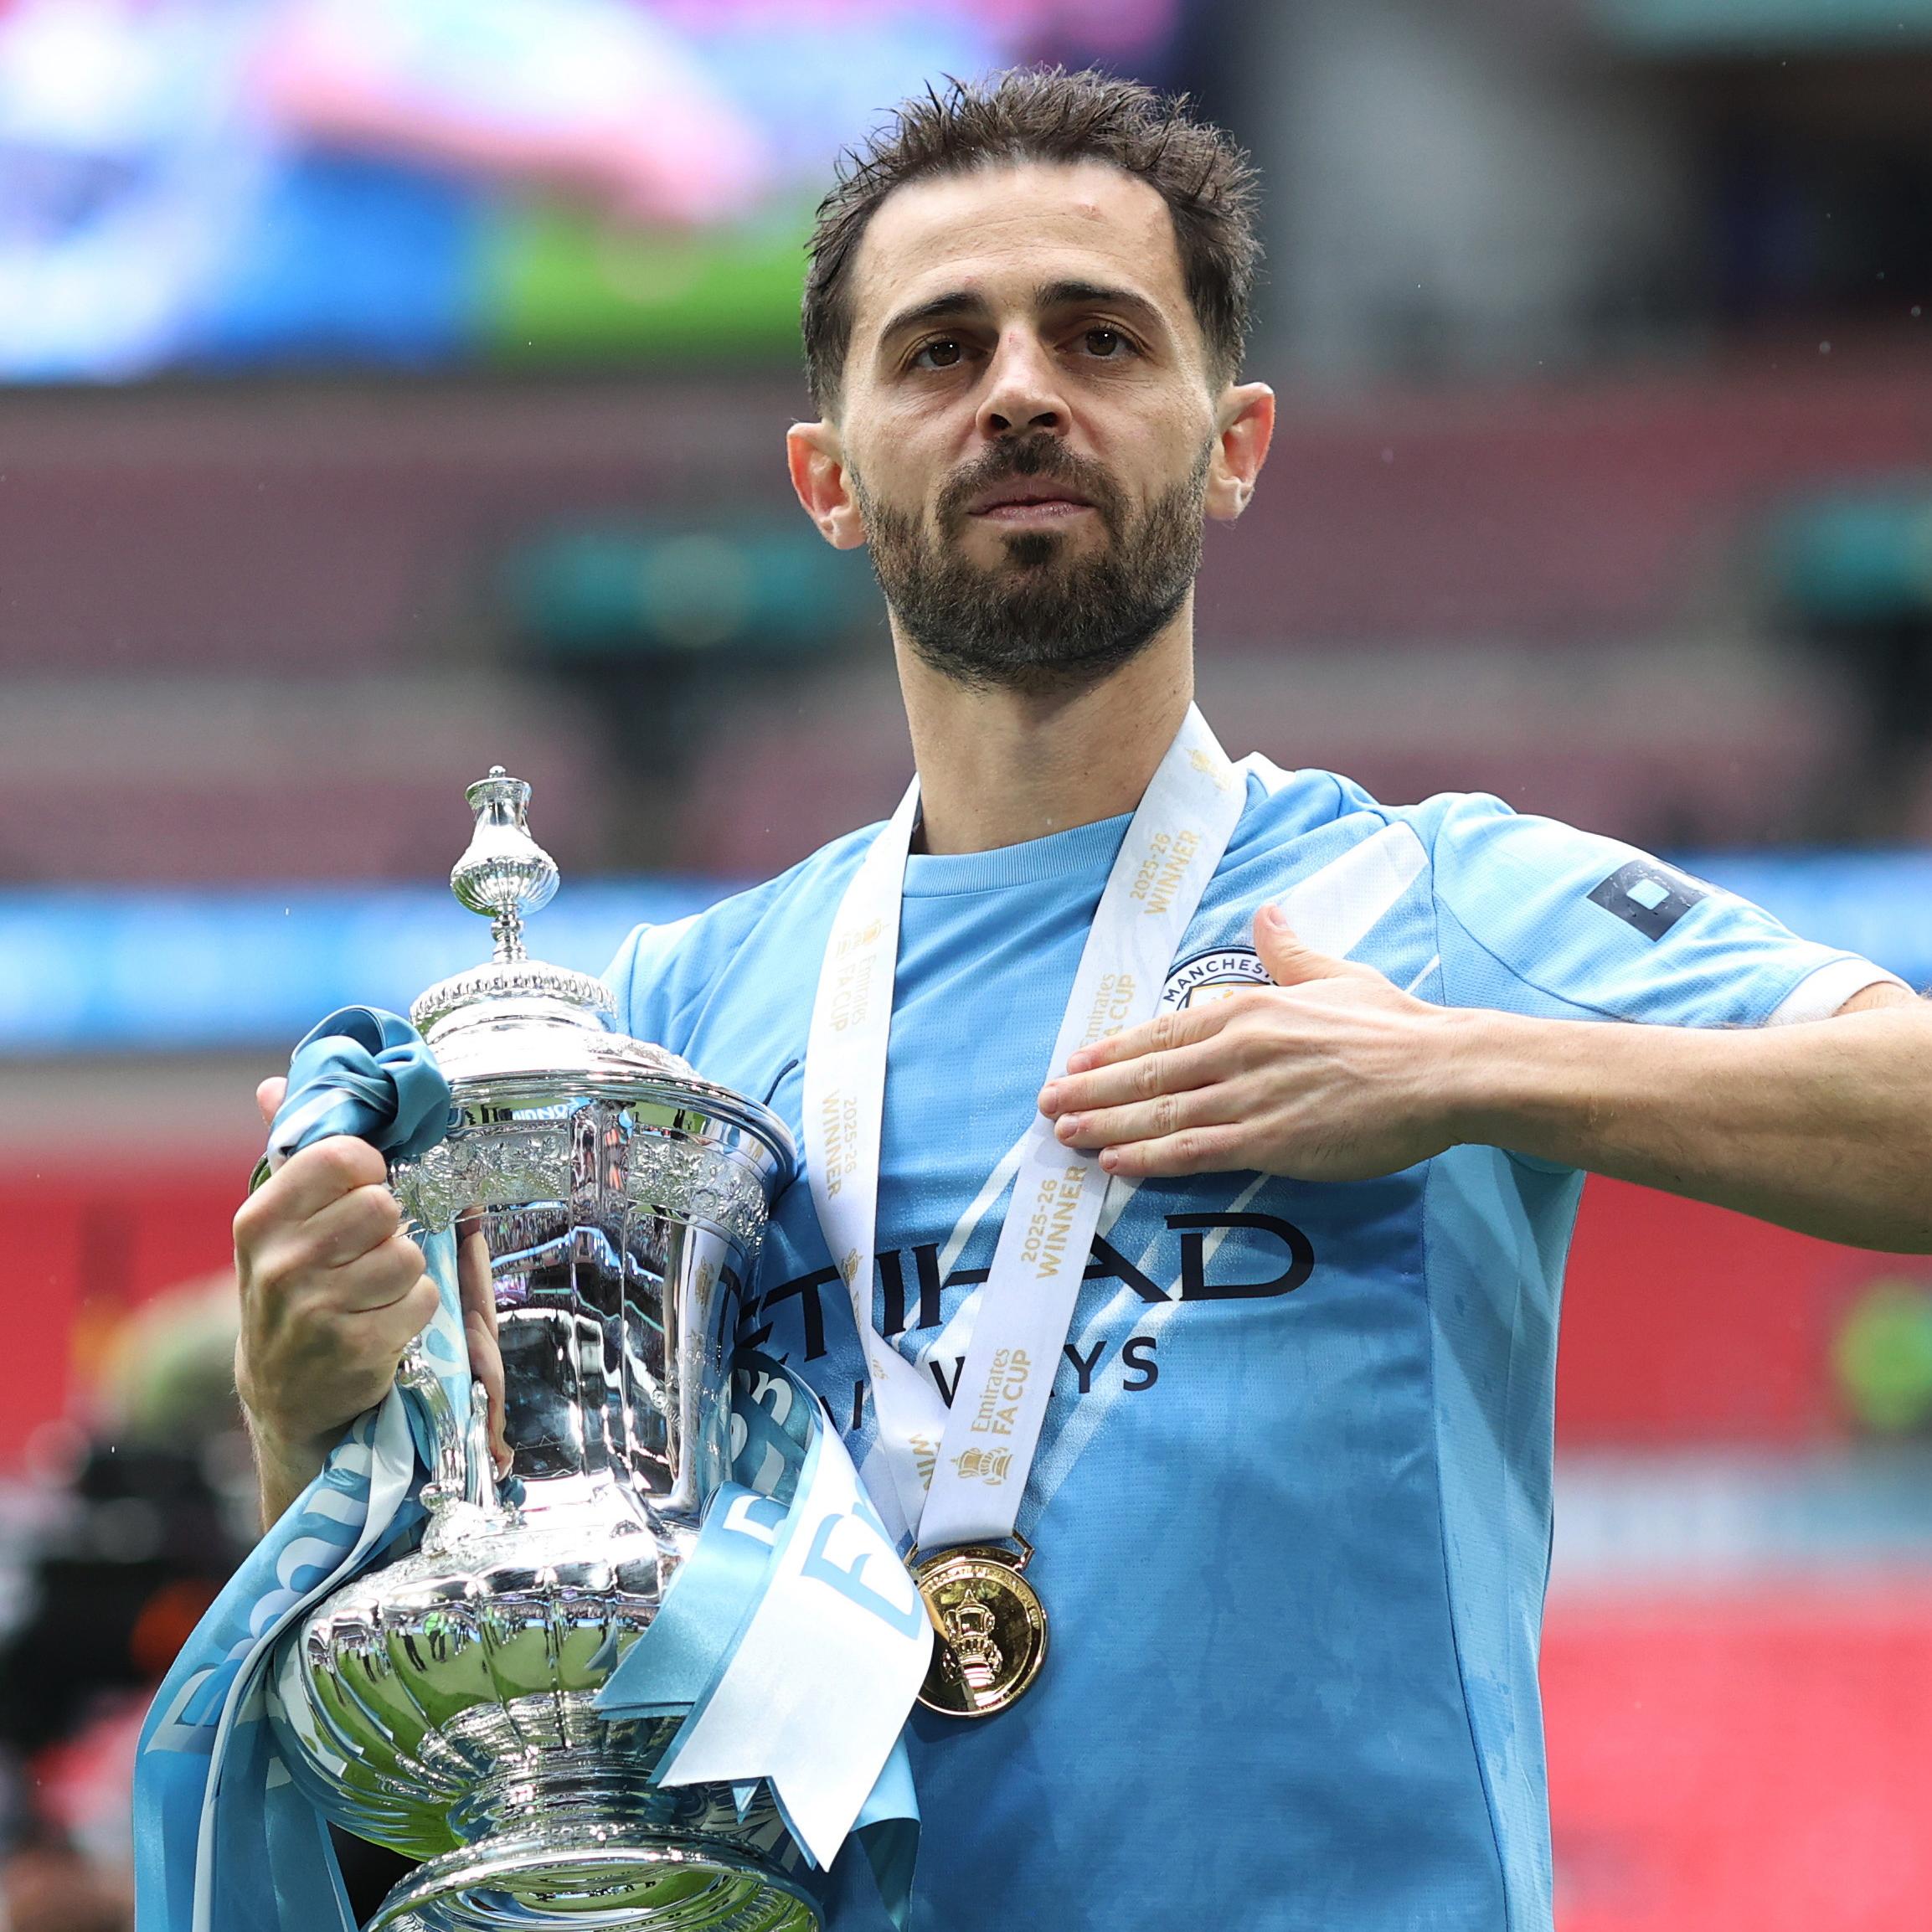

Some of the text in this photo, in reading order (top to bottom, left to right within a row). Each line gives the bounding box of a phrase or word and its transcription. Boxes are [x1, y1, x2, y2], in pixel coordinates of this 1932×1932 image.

[1130, 832, 1171, 899] 2025-26
[1143, 830, 1201, 914] WINNER
[828, 990, 853, 1032] CUP
[1109, 974, 1136, 1020] CUP
[1162, 957, 1270, 1002] MANCHES
[822, 1088, 842, 1201] WINNER
[843, 1096, 858, 1174] 2025-26
[1021, 1179, 1058, 1262] 2025-26
[1036, 1166, 1088, 1279] WINNER
[971, 1348, 1010, 1432] Emirates
[992, 1349, 1032, 1435] FA CUP
